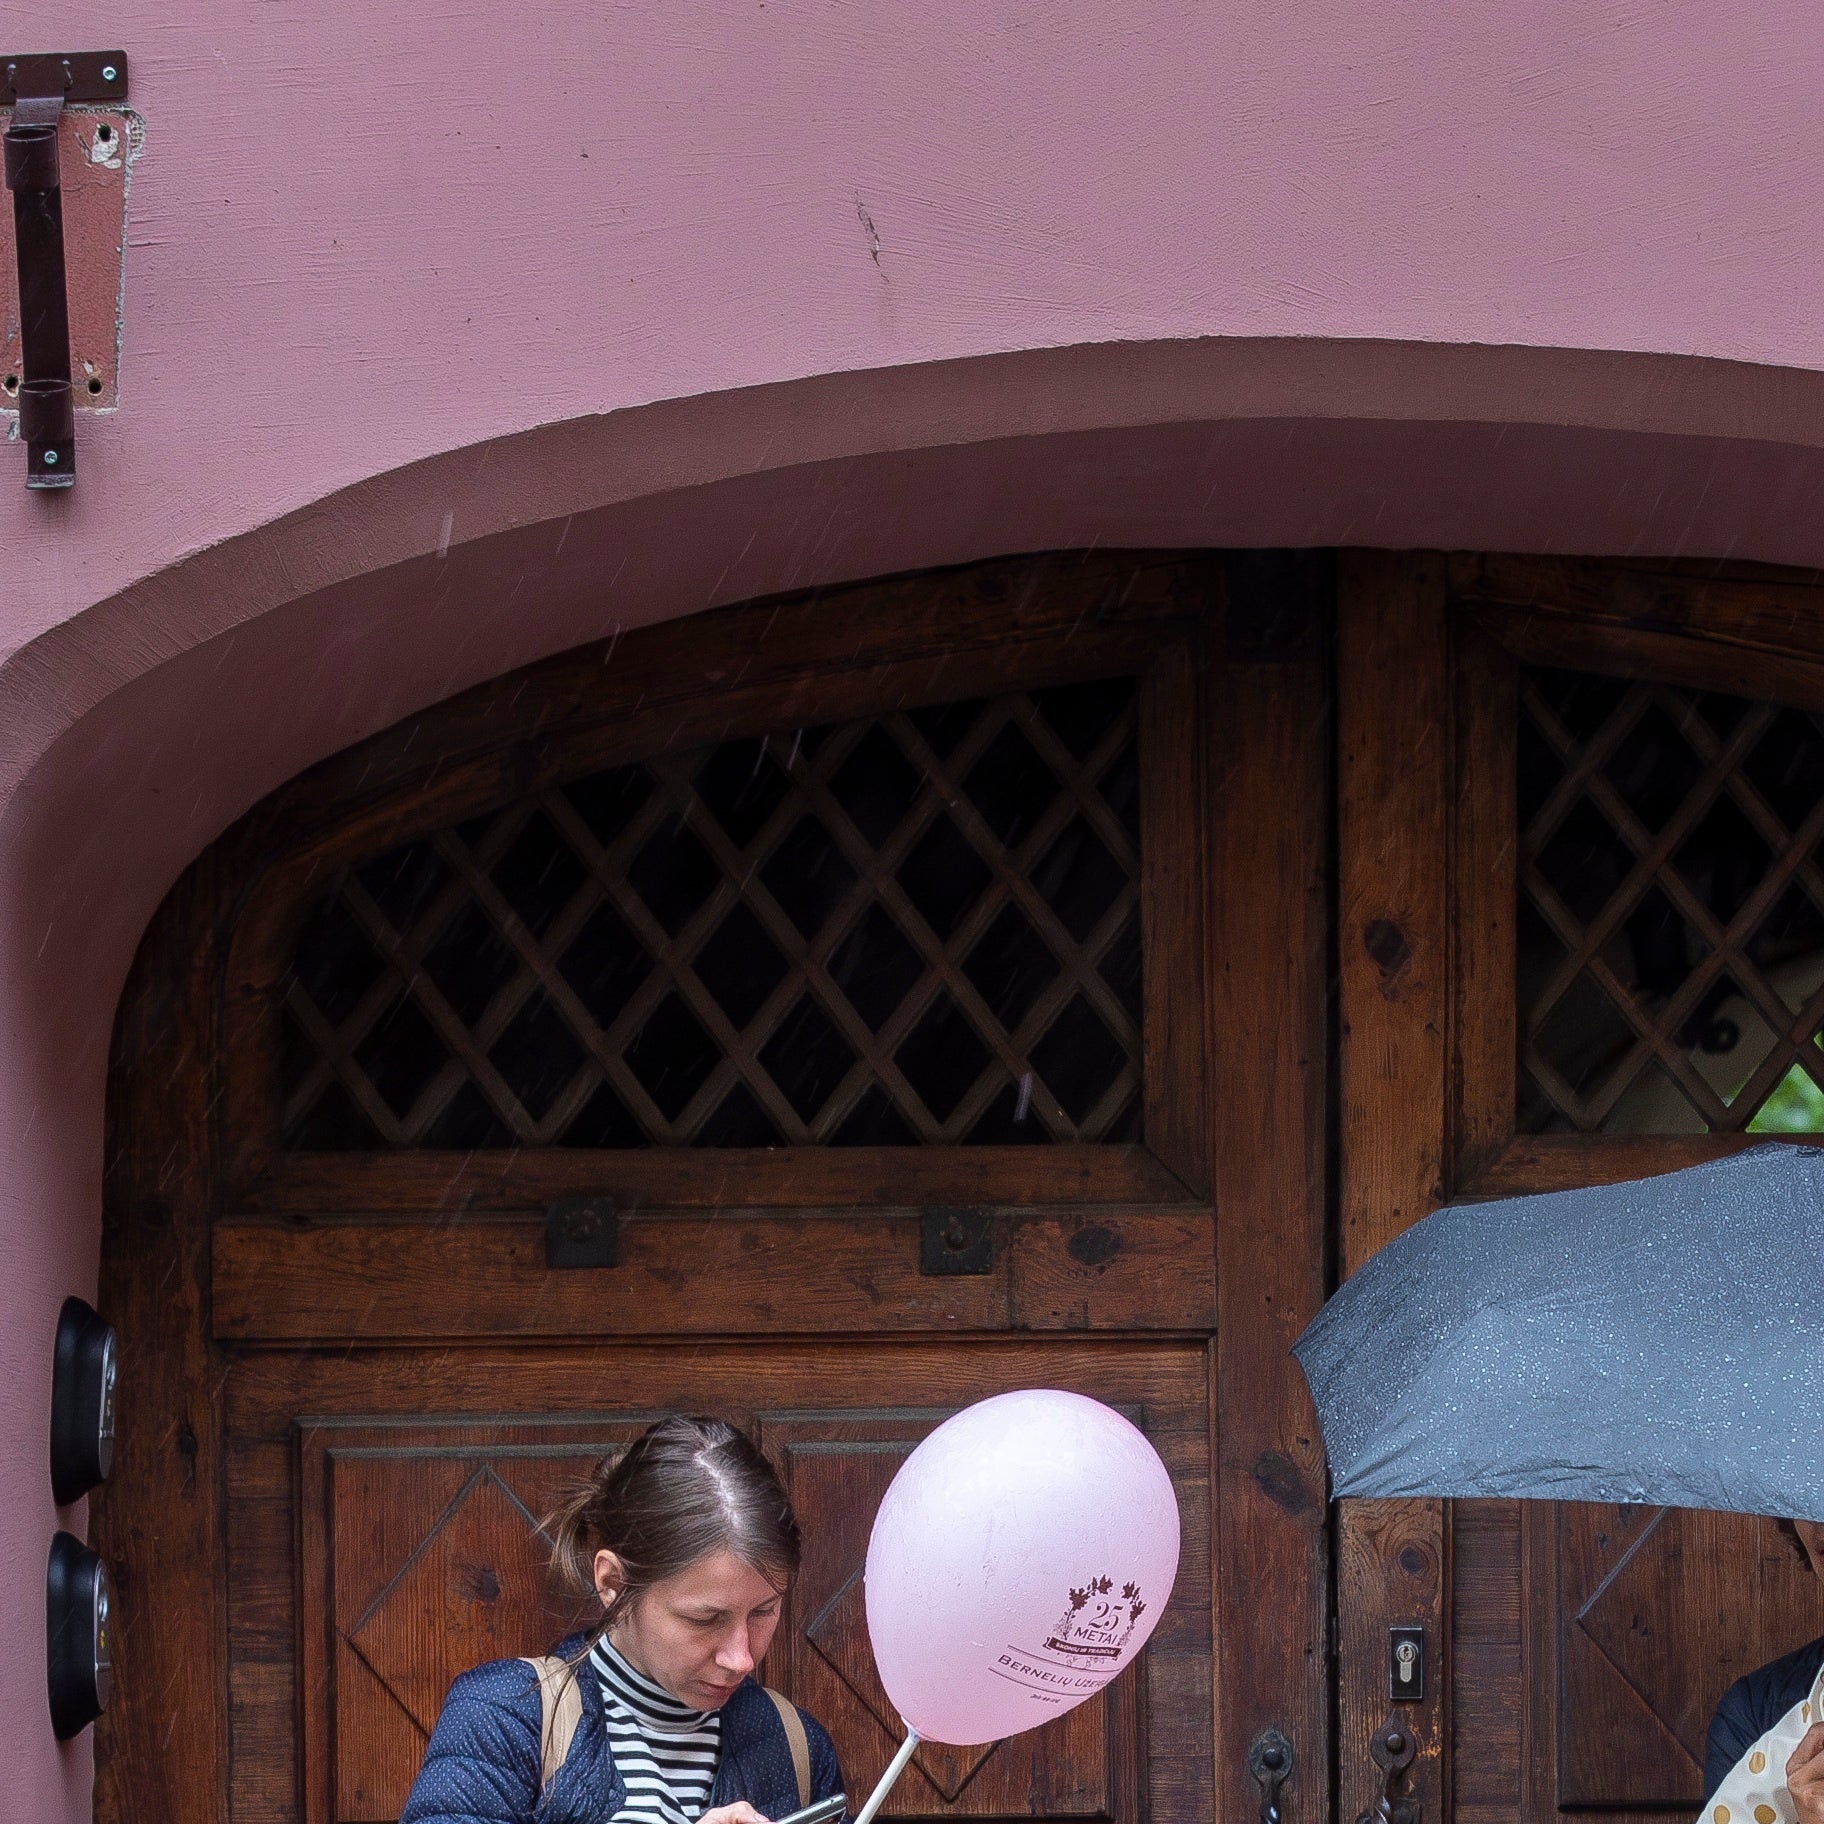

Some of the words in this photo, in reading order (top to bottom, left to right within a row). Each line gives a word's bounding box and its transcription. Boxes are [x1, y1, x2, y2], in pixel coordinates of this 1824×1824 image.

[1087, 1601, 1124, 1632] 25
[1074, 1626, 1118, 1646] METAI
[997, 1654, 1074, 1688] BERNELIŲ
